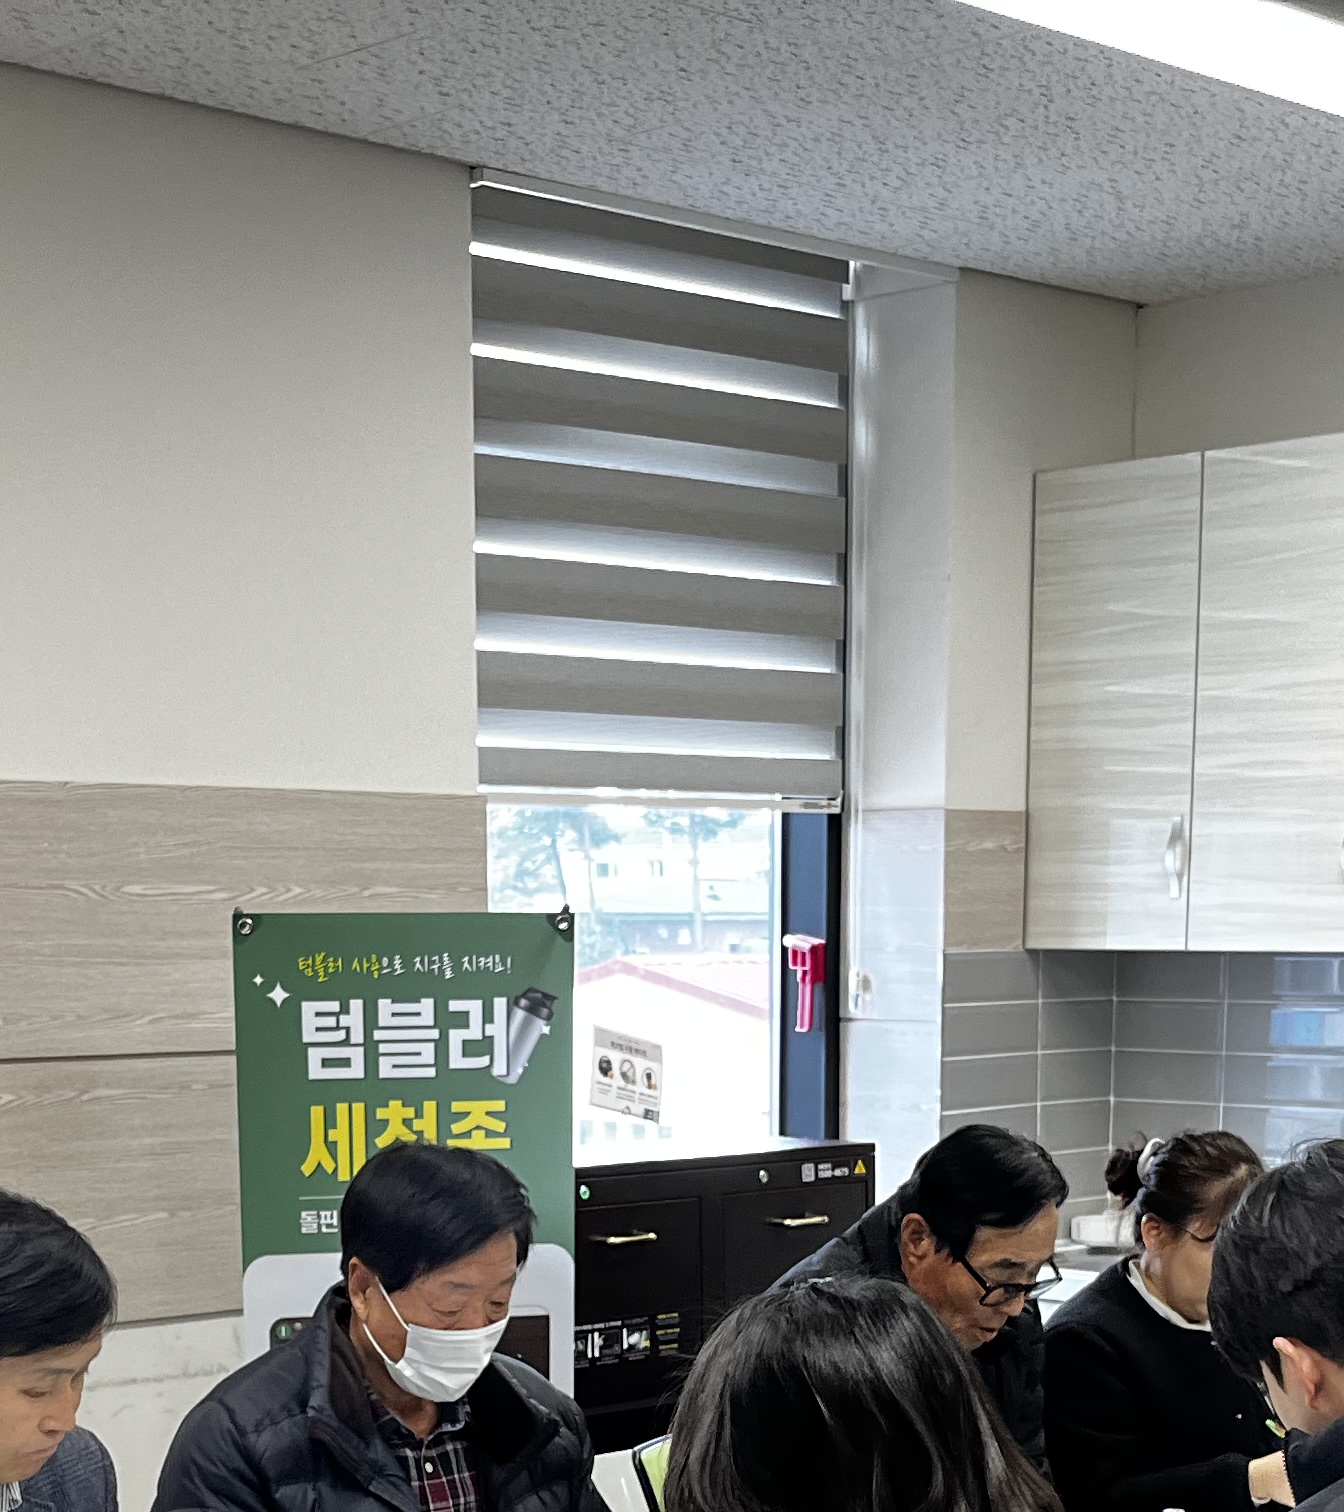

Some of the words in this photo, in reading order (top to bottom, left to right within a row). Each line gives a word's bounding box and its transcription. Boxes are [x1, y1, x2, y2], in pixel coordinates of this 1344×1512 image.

[298, 952, 343, 982] 텀블러
[352, 953, 406, 979] 사용으로
[413, 952, 455, 979] 지구를
[462, 954, 513, 975] 지켜요!
[301, 996, 509, 1081] 텀블러
